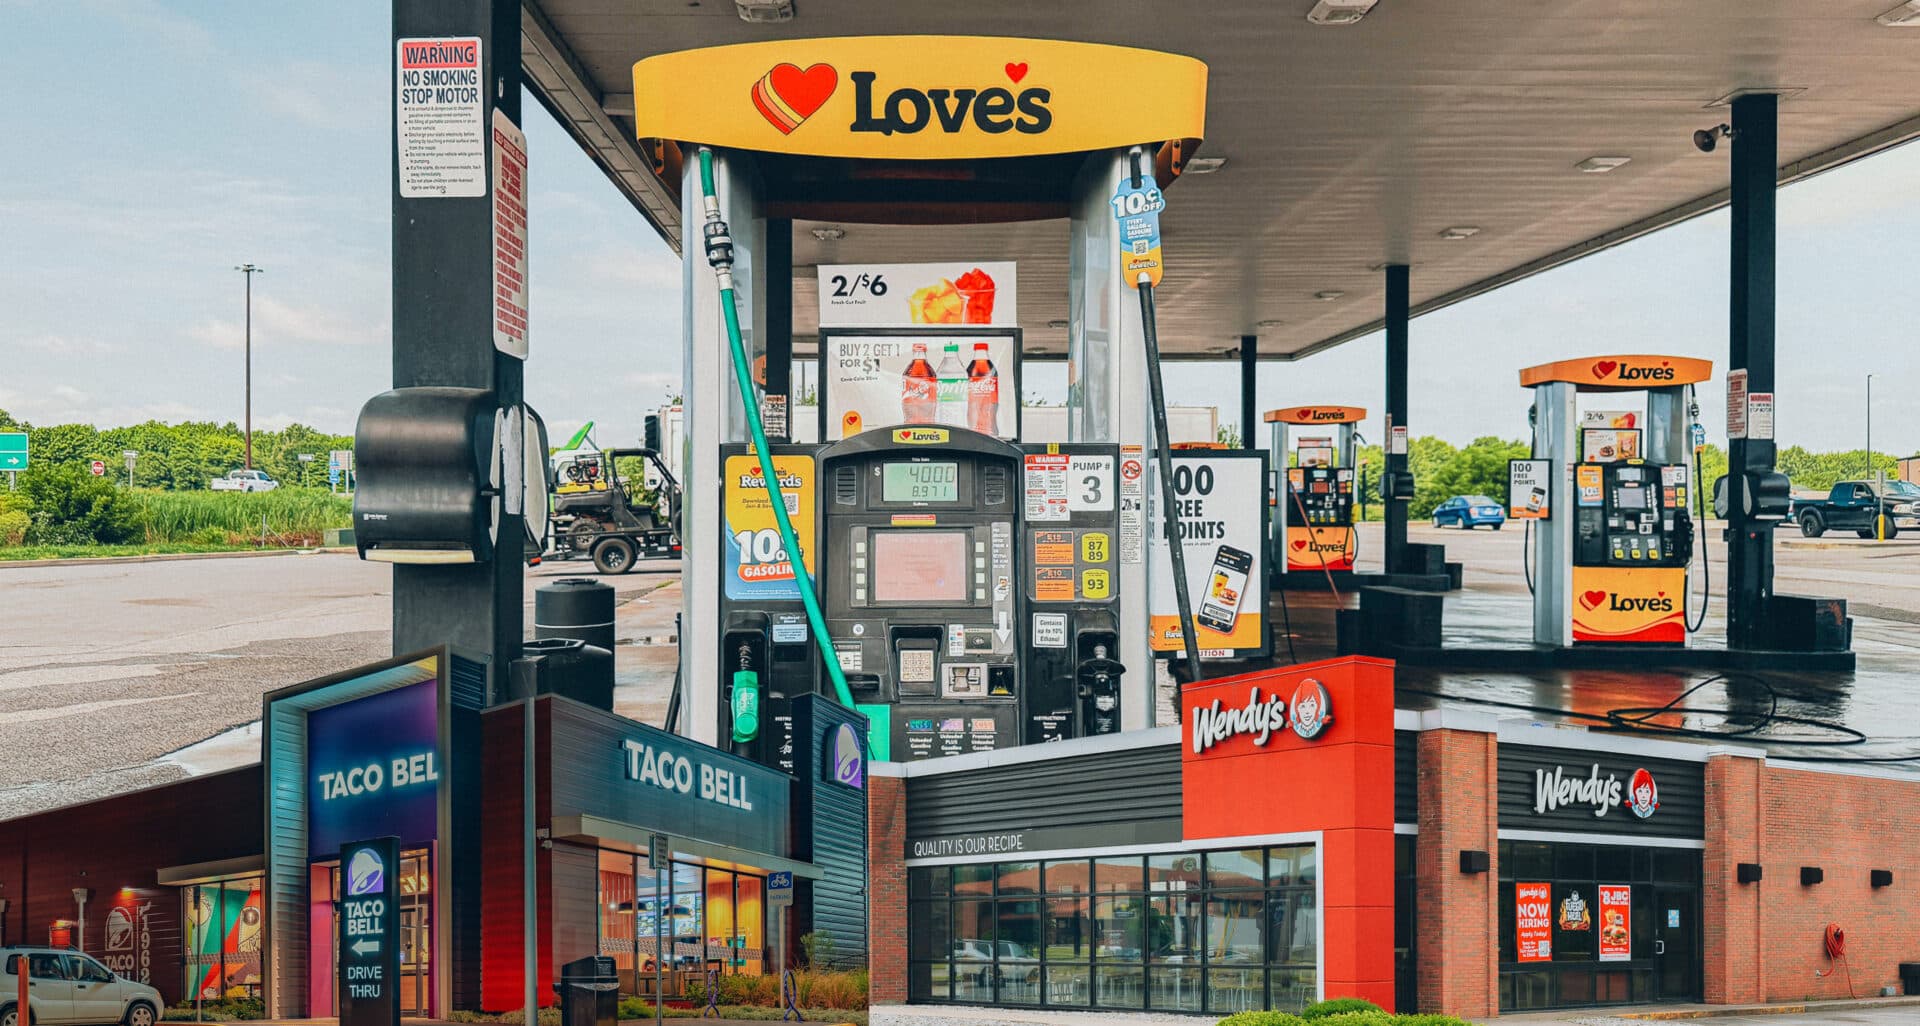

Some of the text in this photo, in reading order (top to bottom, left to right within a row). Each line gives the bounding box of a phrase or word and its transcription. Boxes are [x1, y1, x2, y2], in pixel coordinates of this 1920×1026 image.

[406, 46, 474, 64] WARNING
[403, 69, 477, 86] NO SMOKING
[402, 87, 478, 104] STOP MOTOR
[1143, 202, 1162, 212] OFF
[840, 344, 861, 357] BUY
[863, 344, 870, 357] 2
[873, 344, 893, 357] GET
[840, 359, 861, 368] FOR
[1073, 463, 1102, 471] PUMP
[1513, 463, 1532, 472] 100
[1173, 465, 1214, 495] 00
[1676, 472, 1682, 481] 5
[1082, 475, 1101, 504] 3
[1165, 500, 1202, 517] REE
[1088, 541, 1103, 550] 87
[1088, 551, 1103, 560] 89
[743, 564, 794, 578] GASOLIN
[1087, 579, 1104, 589] 93
[1193, 687, 1285, 754] Wendy's
[624, 738, 752, 810] TACO BELL
[319, 763, 384, 801] TACO
[1534, 763, 1622, 817] Wendy's
[914, 834, 1023, 857] QUALITY IS OUR RECIPE
[1610, 890, 1629, 901] JBC
[345, 899, 384, 918] TACO
[1518, 903, 1549, 918] NOW
[347, 918, 384, 936] BELL
[1518, 918, 1549, 928] HIRING
[104, 954, 135, 971] TACO
[347, 965, 382, 980] DRIVE
[349, 984, 381, 998] THRU
